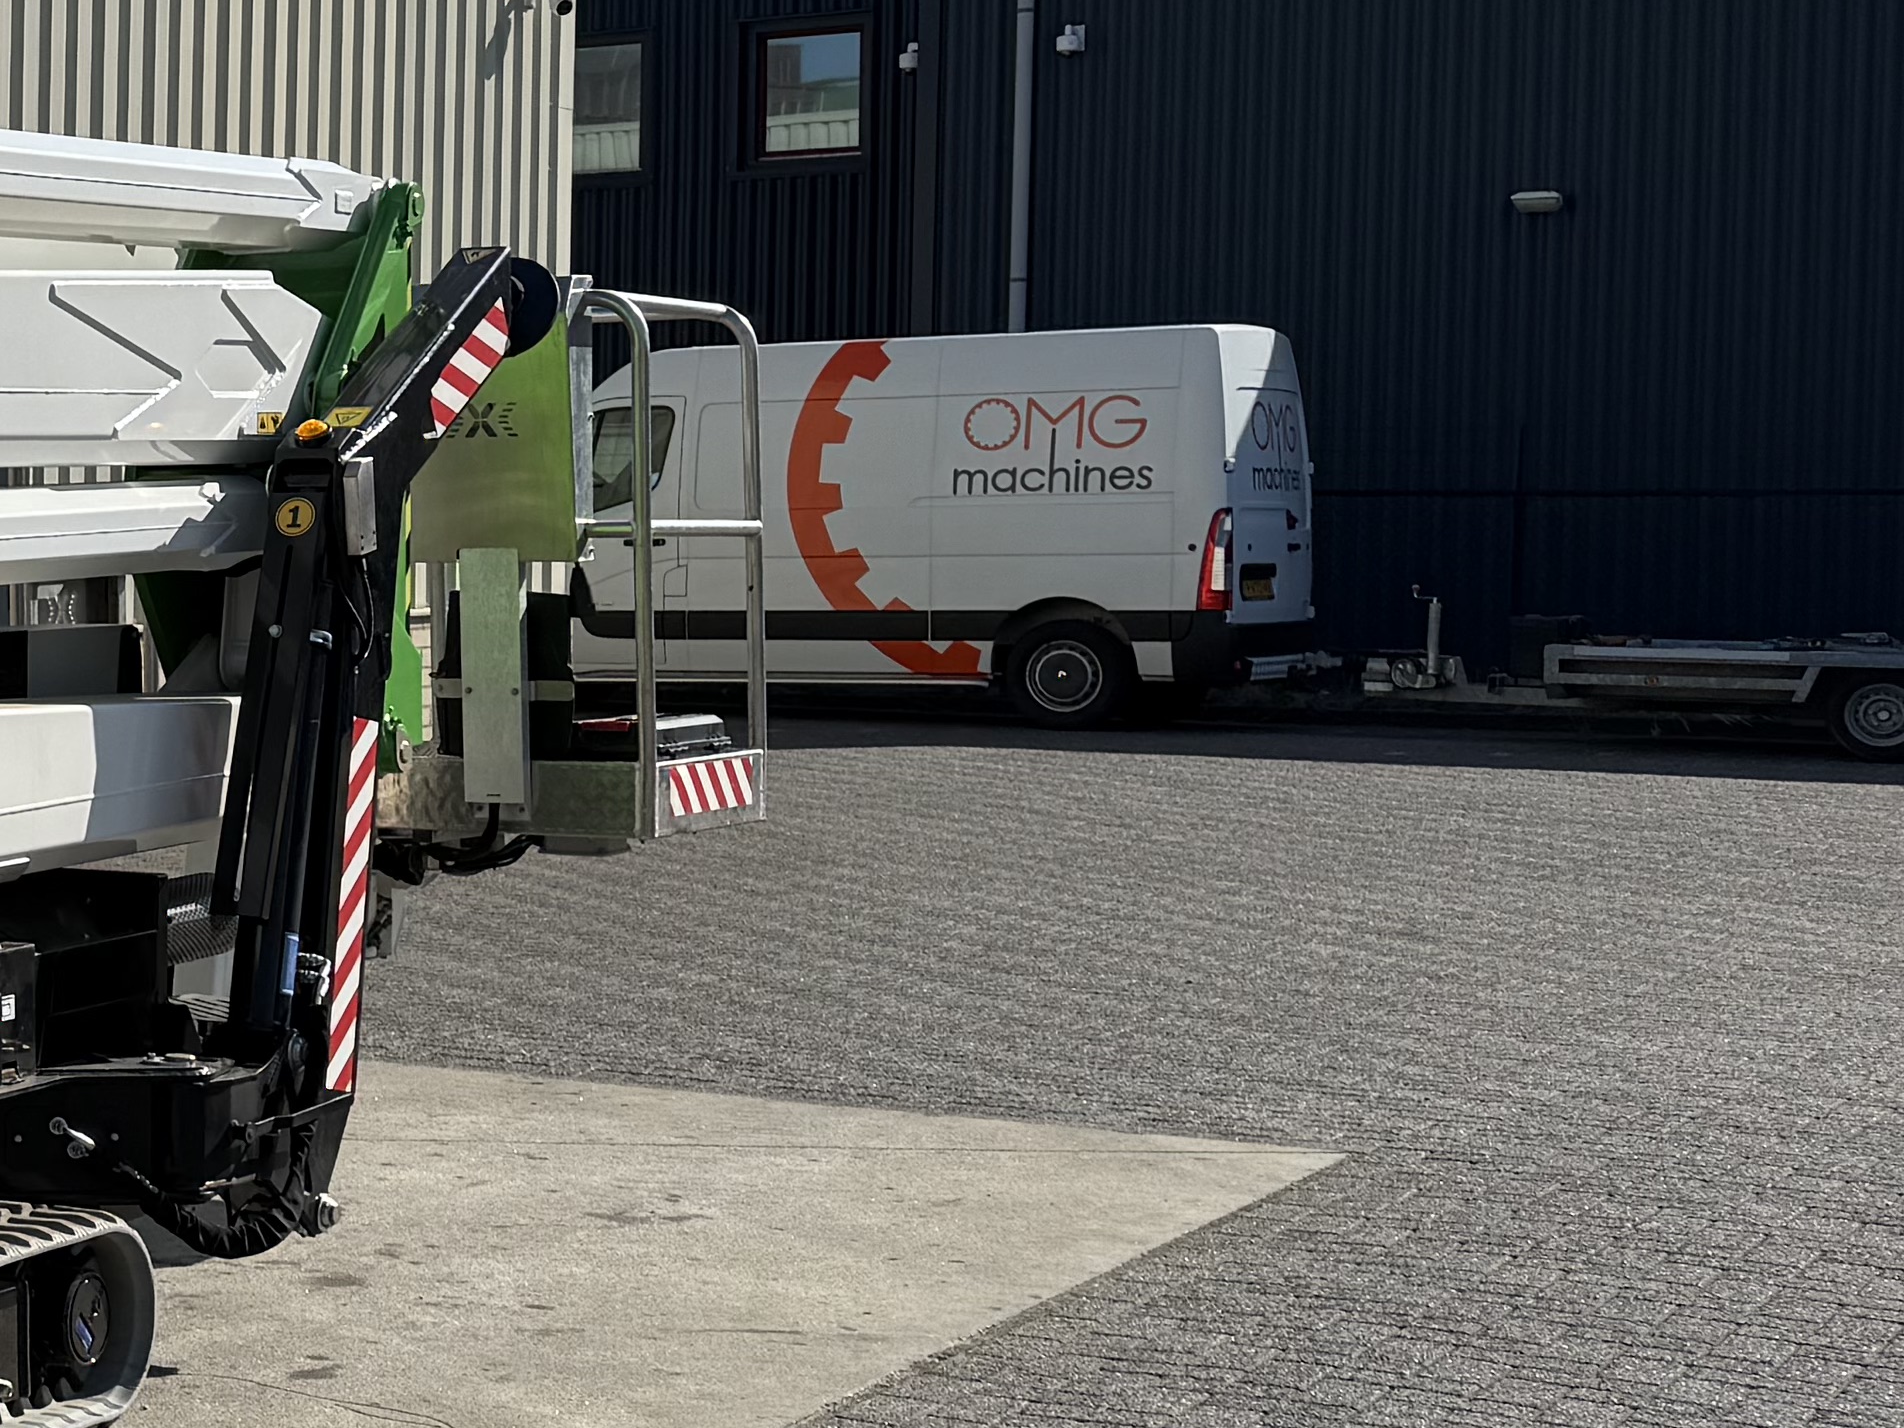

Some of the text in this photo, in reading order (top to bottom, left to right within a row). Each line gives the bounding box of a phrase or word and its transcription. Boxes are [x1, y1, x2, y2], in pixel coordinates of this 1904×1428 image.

[963, 394, 1148, 452] OMG
[1251, 400, 1298, 454] OMG
[952, 427, 1154, 496] machines
[287, 505, 301, 528] 1
